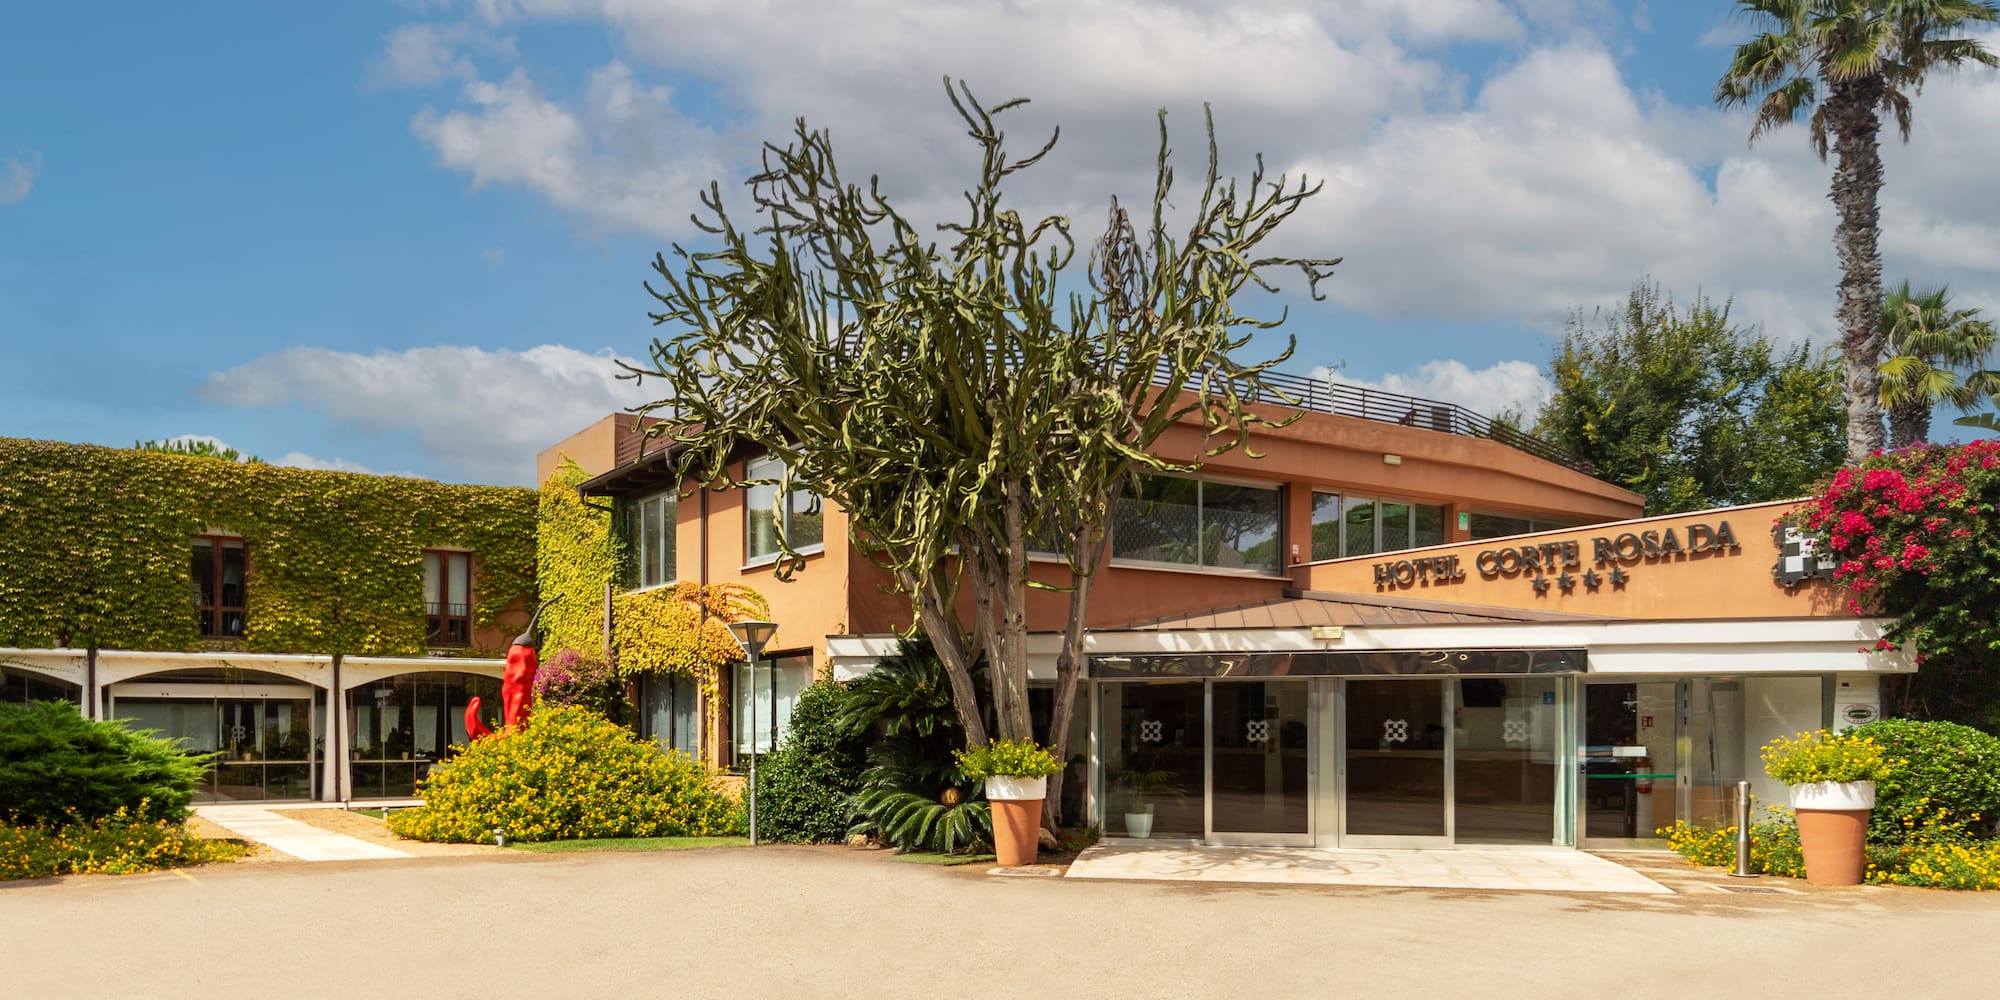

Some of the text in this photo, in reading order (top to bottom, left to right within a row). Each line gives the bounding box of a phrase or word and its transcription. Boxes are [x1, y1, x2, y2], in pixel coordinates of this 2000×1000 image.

[1373, 521, 1740, 585] HOTEL CORTE ROSADA
